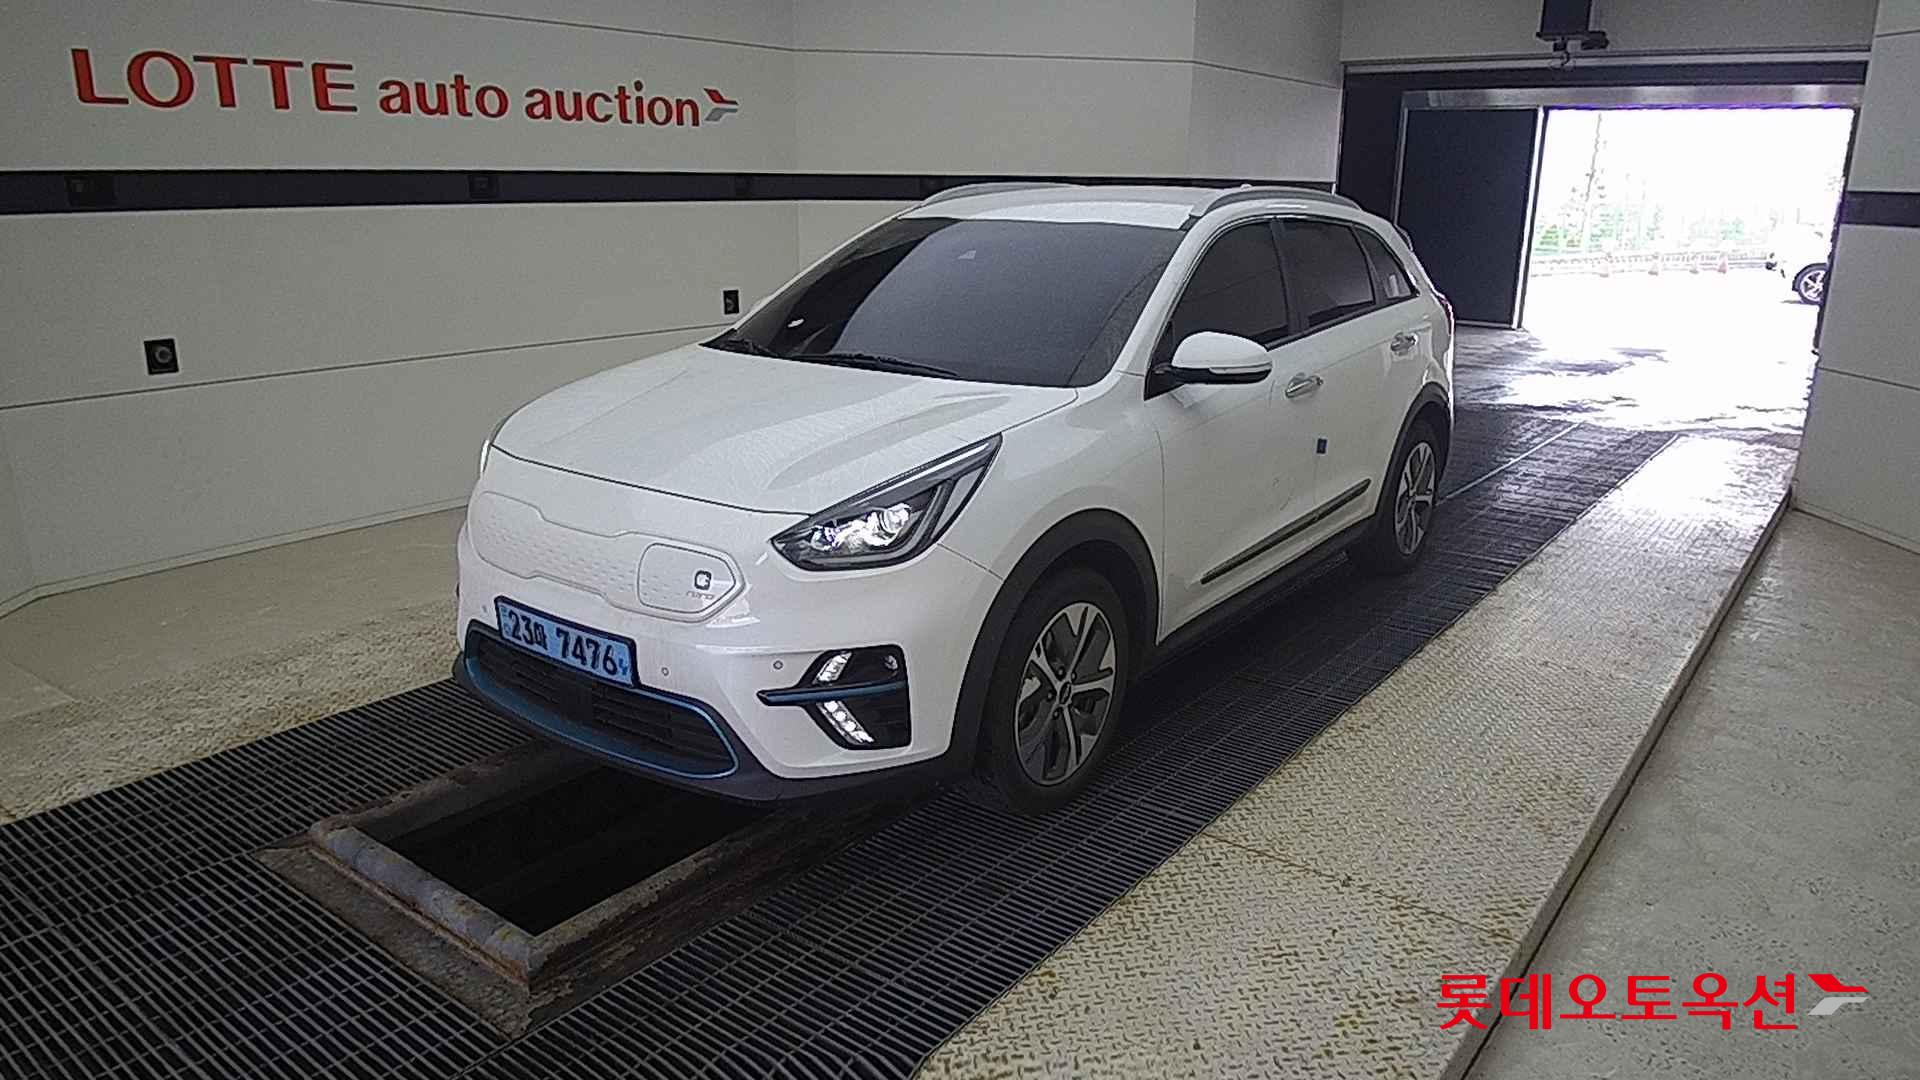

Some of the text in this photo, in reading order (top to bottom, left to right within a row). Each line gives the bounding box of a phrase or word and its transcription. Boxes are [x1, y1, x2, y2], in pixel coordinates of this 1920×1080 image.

[70, 48, 700, 127] LOTTE auto auction
[556, 627, 618, 675] 7476
